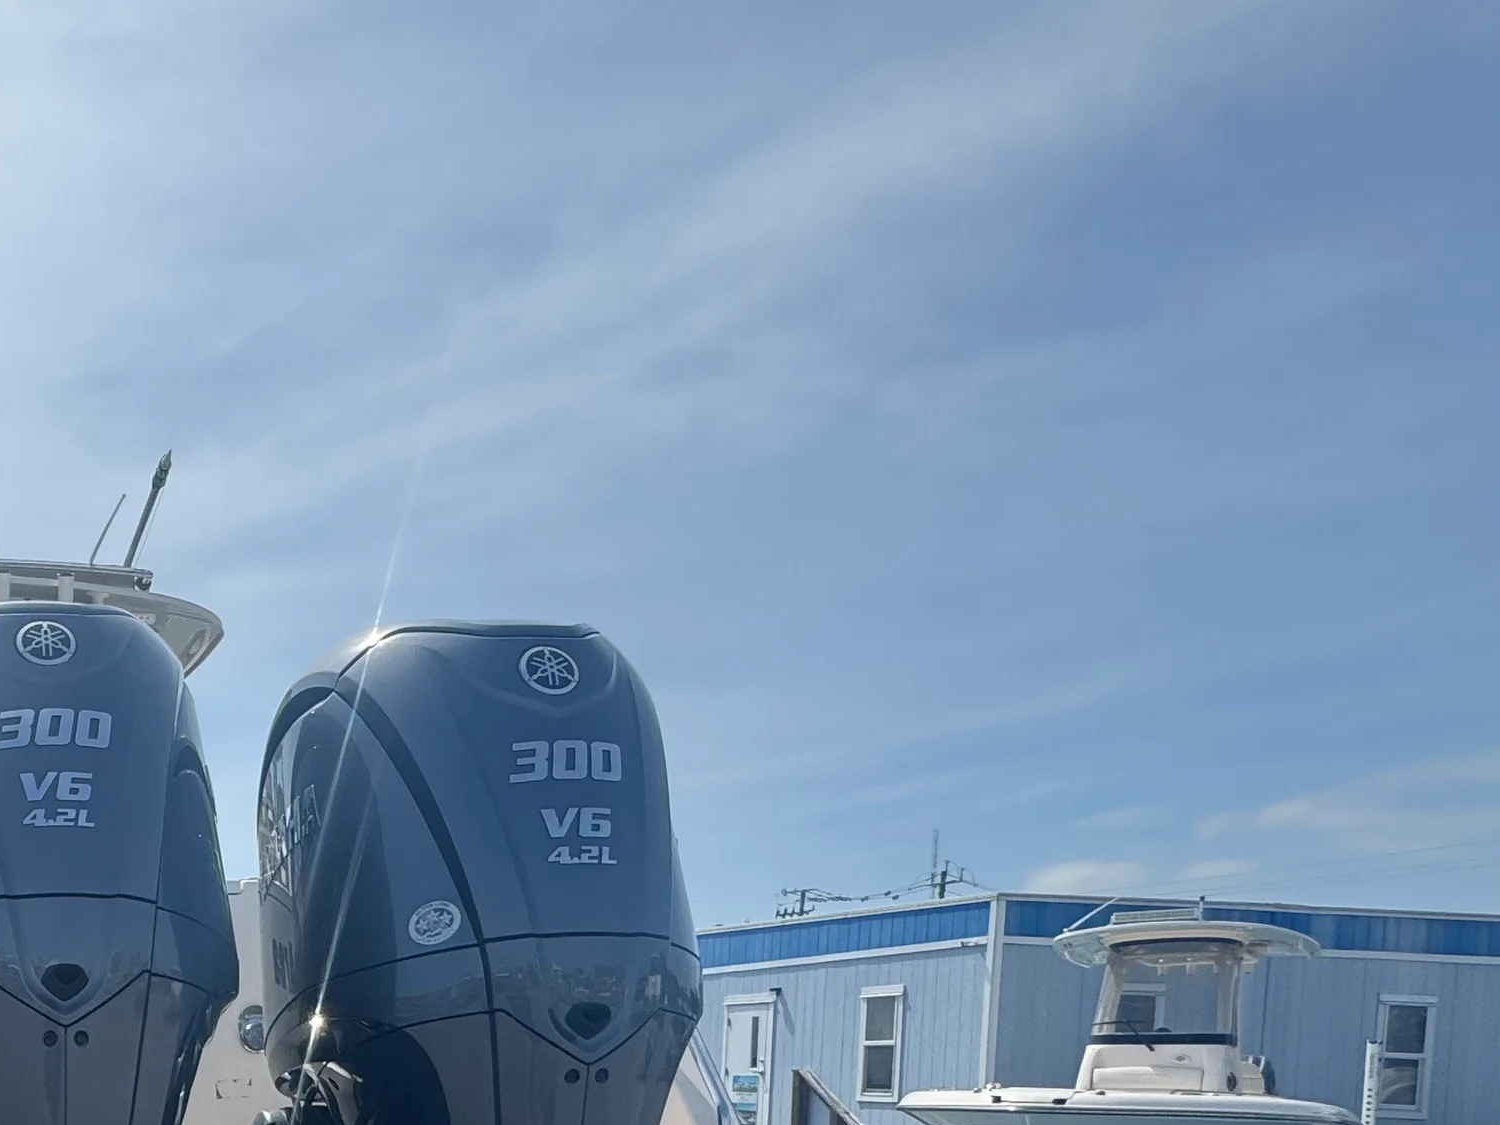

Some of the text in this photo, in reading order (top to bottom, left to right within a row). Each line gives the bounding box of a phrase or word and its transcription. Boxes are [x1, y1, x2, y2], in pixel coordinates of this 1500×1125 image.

[509, 740, 622, 783] 300
[19, 771, 93, 801] V6
[22, 808, 95, 827] 4.2L
[540, 807, 612, 838] V6
[547, 846, 618, 864] 4.2L
